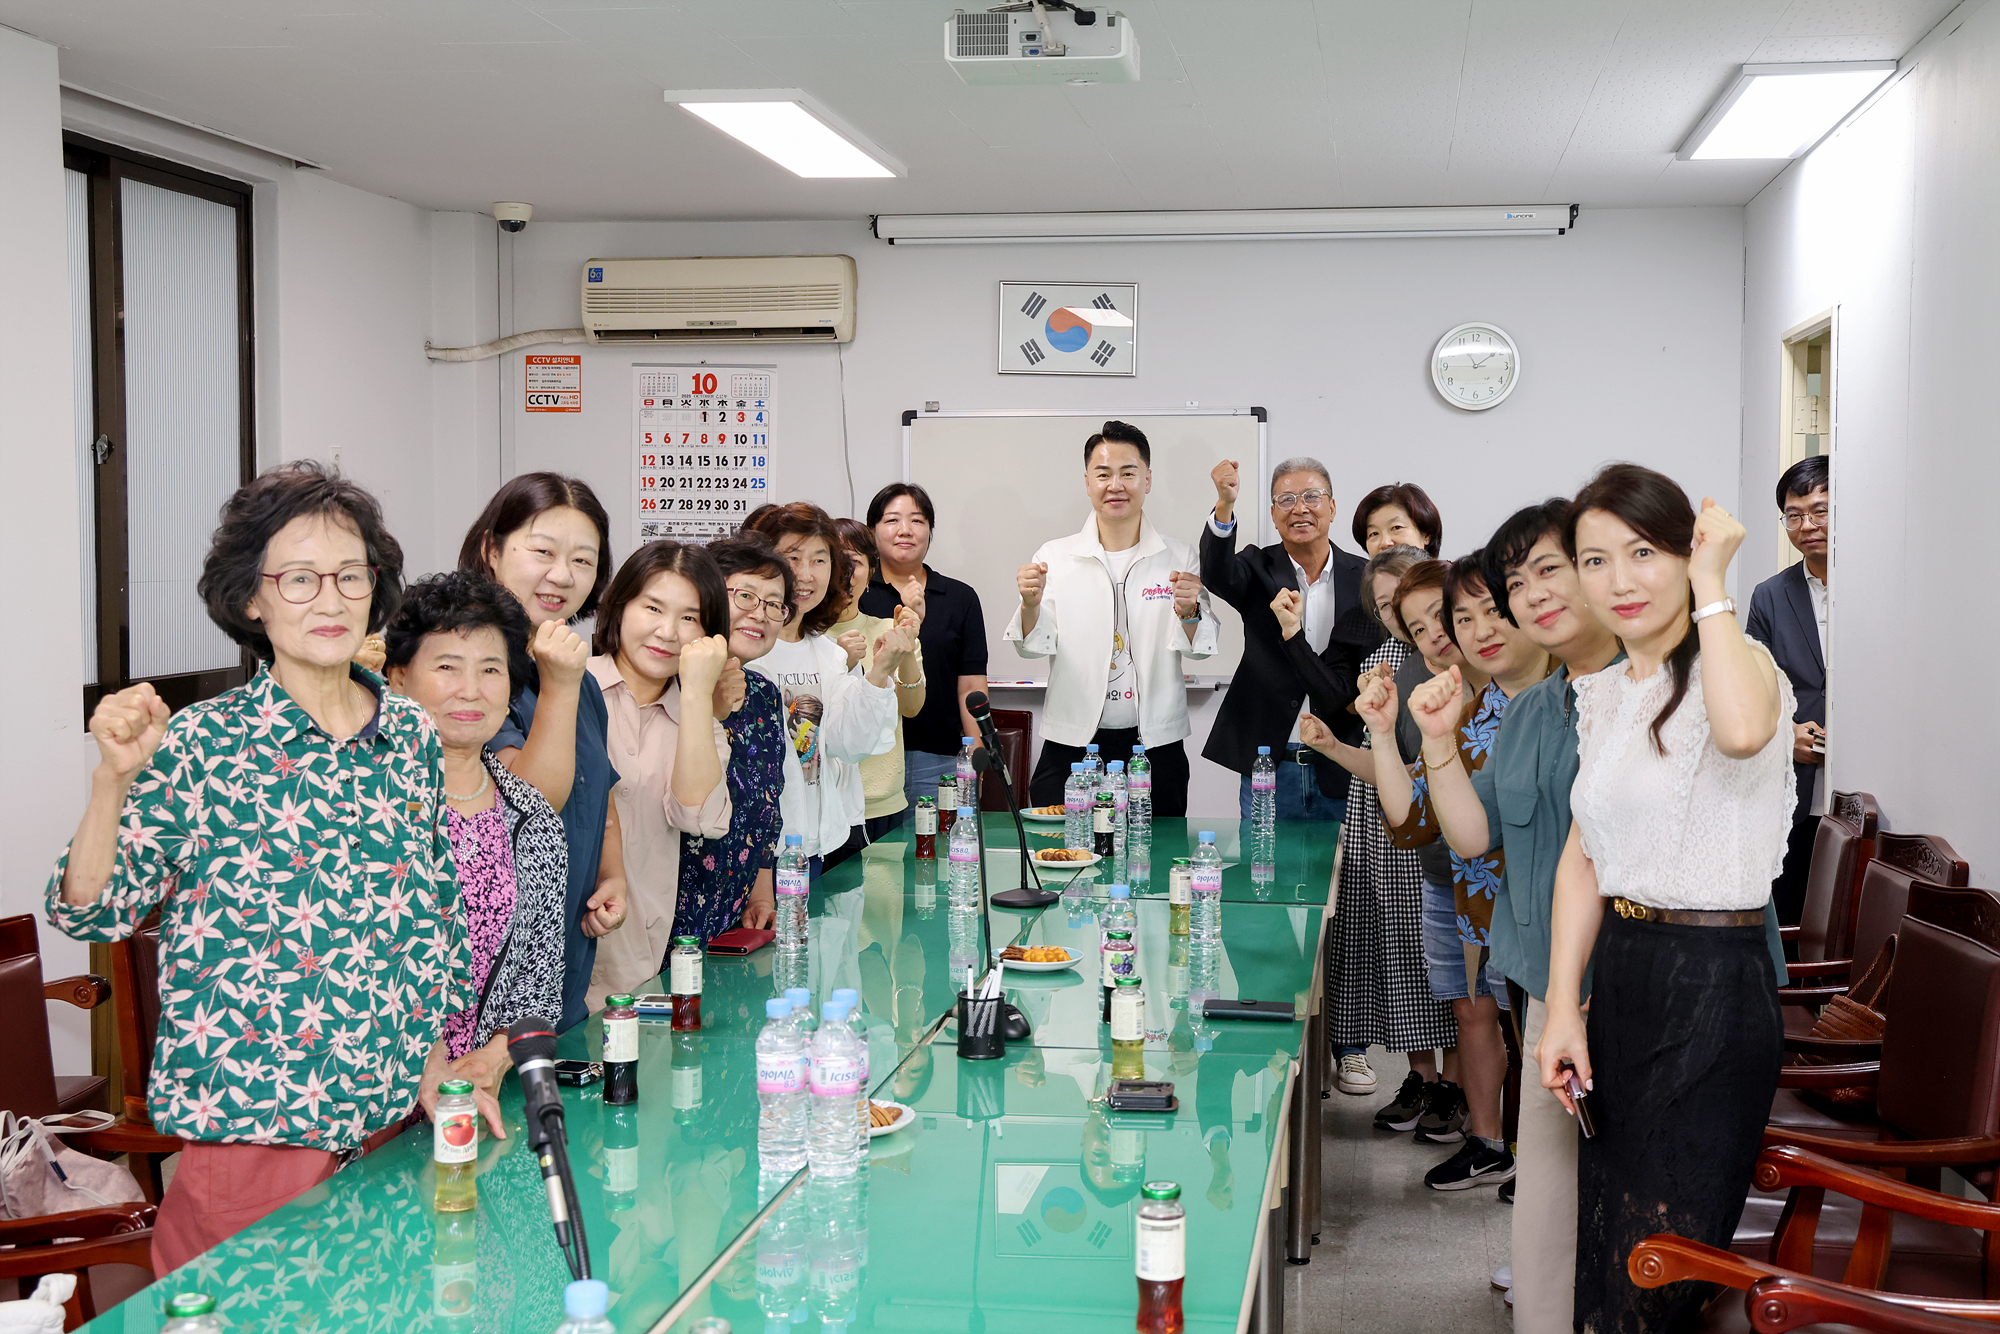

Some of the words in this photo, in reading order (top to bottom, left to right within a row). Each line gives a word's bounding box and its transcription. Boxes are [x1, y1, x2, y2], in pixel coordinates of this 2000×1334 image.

[1472, 334, 1480, 342] 12
[1443, 363, 1448, 371] 9
[1504, 362, 1509, 370] 3
[692, 373, 718, 394] 10
[1447, 377, 1454, 385] 8
[1498, 376, 1503, 384] 4
[1460, 387, 1464, 396] 7
[1473, 390, 1478, 399] 6
[1489, 387, 1493, 395] 5
[528, 395, 560, 405] CCTV
[702, 412, 706, 422] 1
[719, 412, 726, 422] 2
[738, 412, 744, 422] 3
[756, 412, 763, 422] 4
[645, 433, 652, 443] 5
[664, 433, 671, 443] 6
[683, 434, 689, 444] 7
[701, 434, 707, 444] 8
[719, 434, 726, 444] 9
[734, 434, 747, 444] 10
[754, 434, 765, 444] 11
[642, 455, 655, 465] 12
[661, 455, 673, 465] 13
[680, 456, 692, 466] 14
[698, 456, 710, 466] 15
[716, 456, 728, 466] 16
[734, 456, 746, 466] 17
[753, 457, 765, 466] 18
[642, 477, 655, 487] 19
[660, 477, 674, 487] 20
[680, 478, 692, 488] 21
[697, 478, 711, 488] 22
[715, 478, 729, 488] 23
[733, 478, 747, 488] 24
[751, 478, 765, 488] 25
[641, 499, 656, 509] 26
[660, 499, 674, 509] 27
[679, 499, 693, 509] 28
[697, 500, 711, 510] 29
[715, 500, 728, 510] 30
[734, 500, 746, 510] 31
[830, 1072, 851, 1082] ICIS
